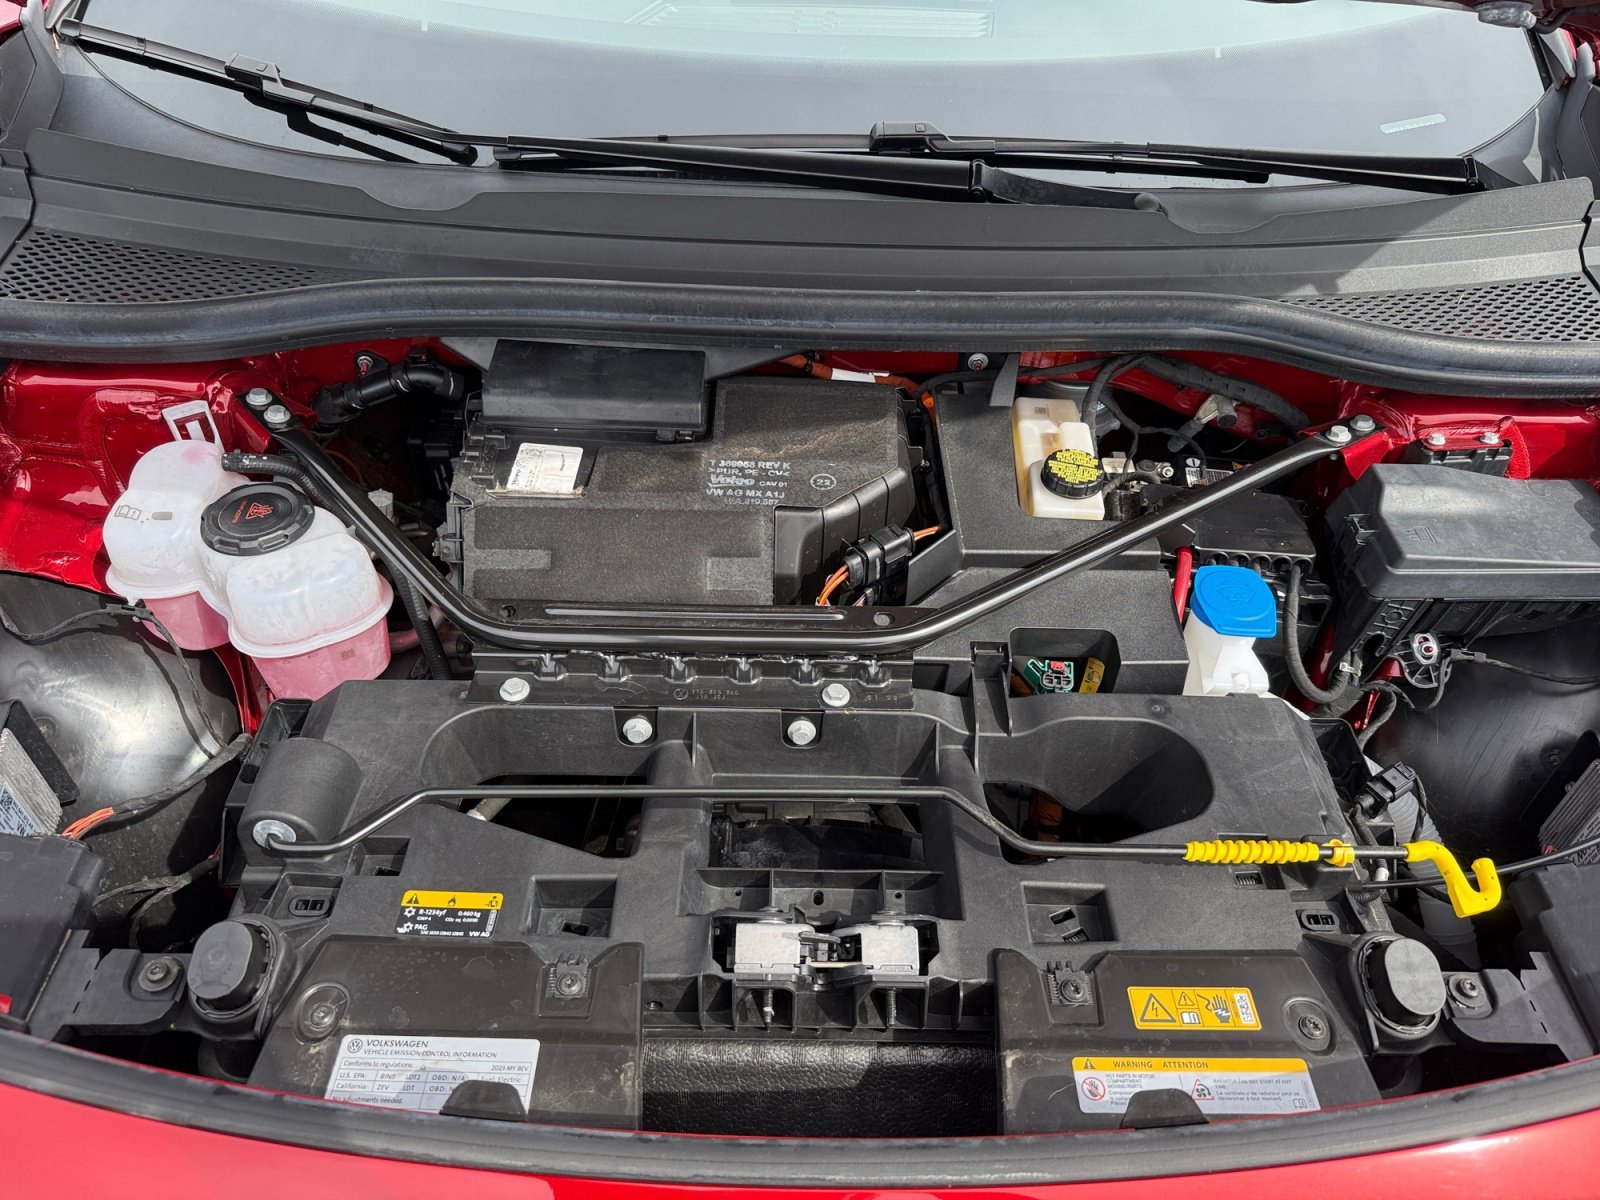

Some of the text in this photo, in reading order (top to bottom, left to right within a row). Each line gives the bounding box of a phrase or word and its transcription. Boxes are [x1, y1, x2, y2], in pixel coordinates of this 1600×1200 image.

[758, 461, 781, 469] REV
[710, 474, 756, 486] Valeo
[706, 488, 724, 496] VW
[726, 489, 743, 497] AG
[418, 908, 447, 917] R-1234yf
[367, 1039, 429, 1048] VOLKSWAGEN
[390, 1049, 420, 1057] EMISSION
[453, 1051, 497, 1059] INFORMATION
[1113, 1061, 1209, 1069] WARNING ATTENTION
